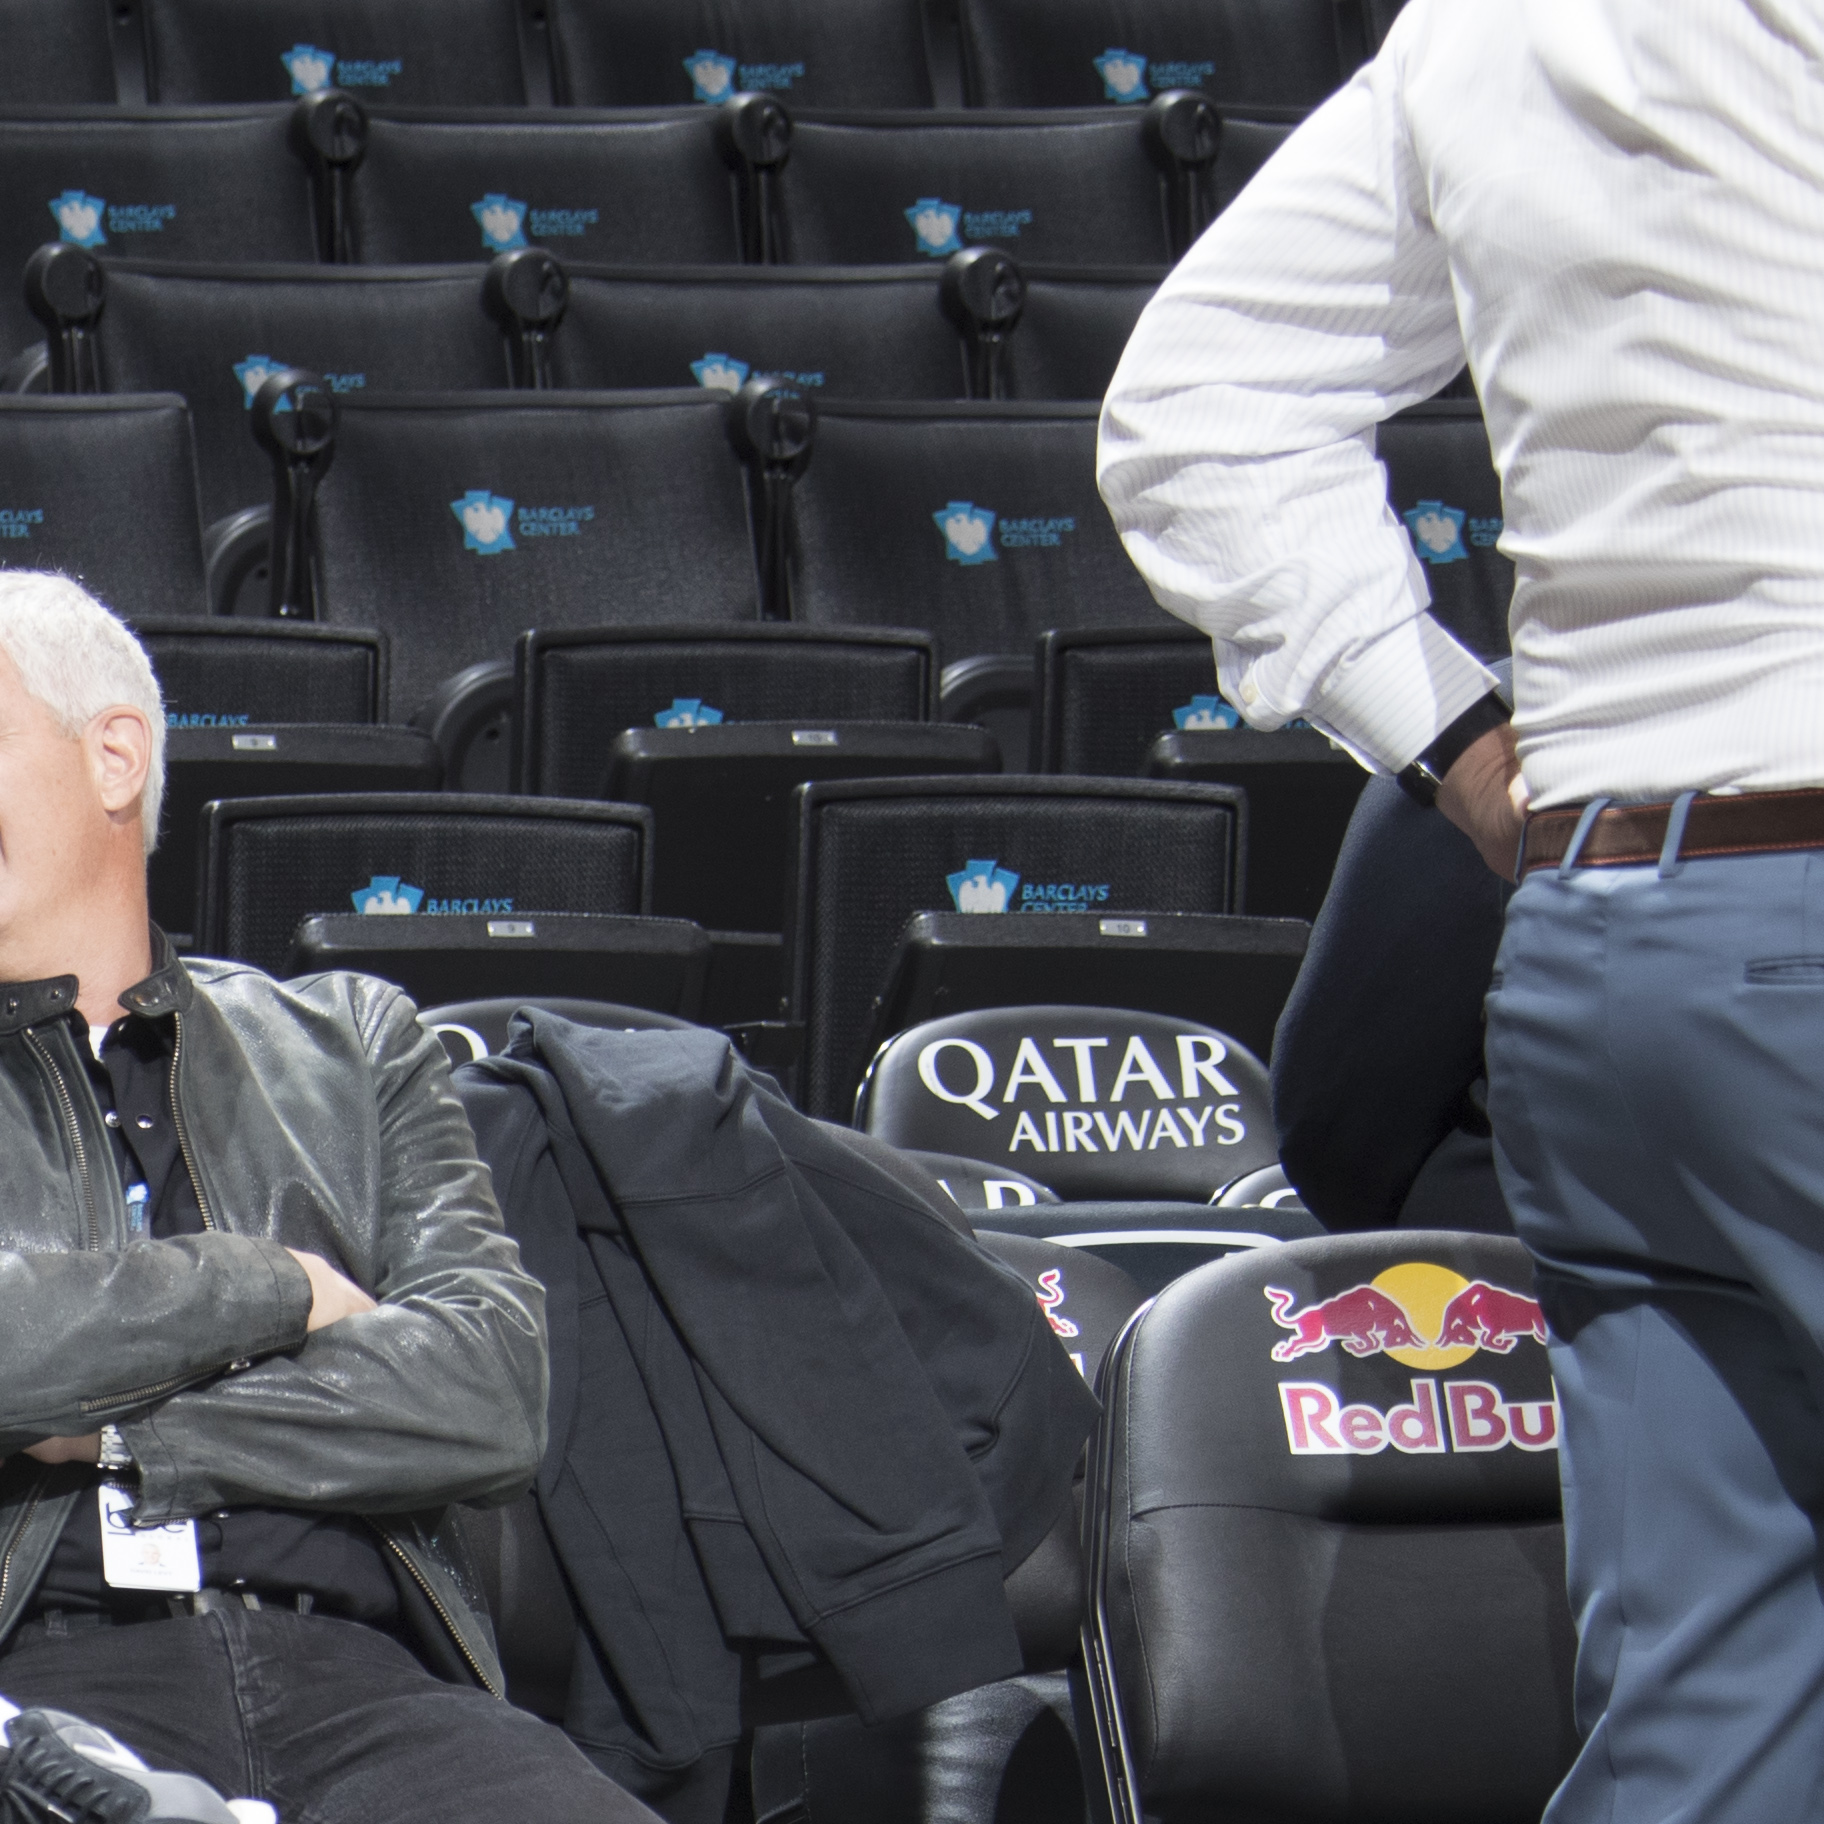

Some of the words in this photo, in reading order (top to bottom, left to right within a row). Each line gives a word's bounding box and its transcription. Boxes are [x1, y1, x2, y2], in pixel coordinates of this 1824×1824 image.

[427, 898, 514, 914] BARCLAYS
[1021, 884, 1110, 901] BARCLAYS
[918, 1035, 1240, 1119] QATAR
[1009, 1105, 1245, 1153] AIRWAYS
[1281, 1380, 1442, 1451] Red
[1446, 1383, 1557, 1449] Bu
